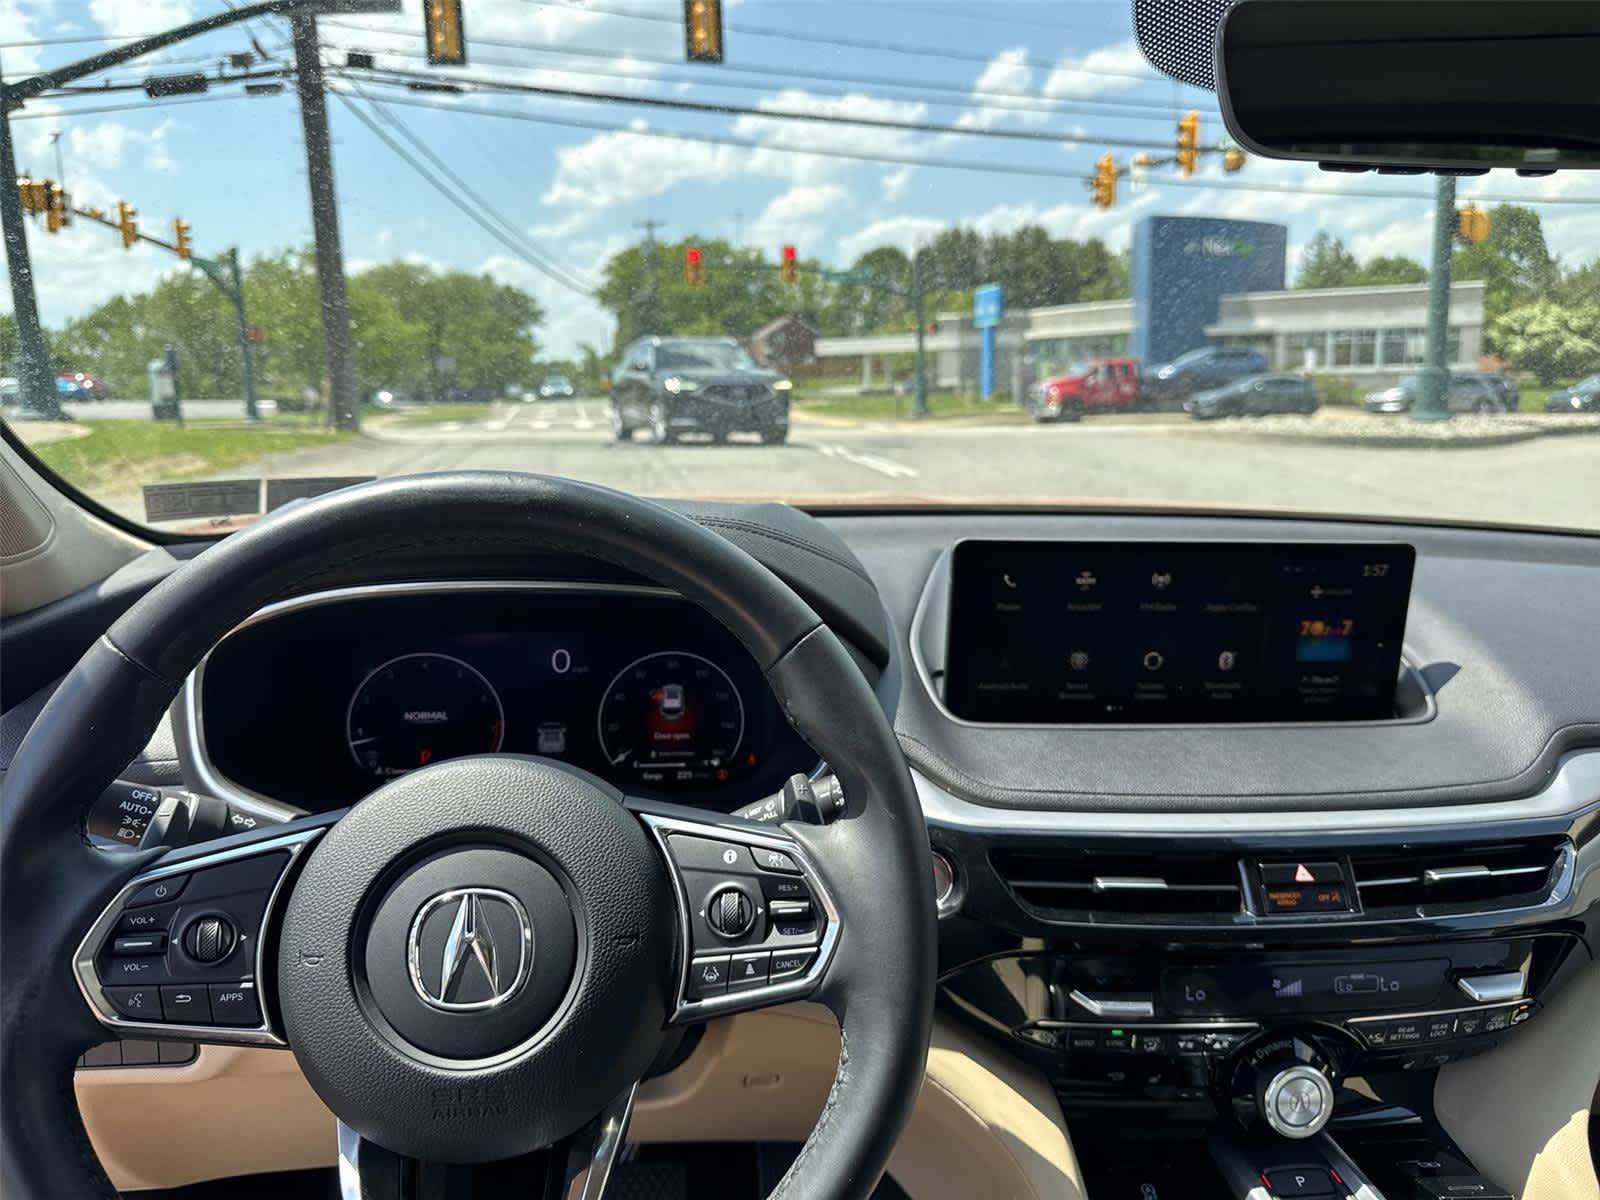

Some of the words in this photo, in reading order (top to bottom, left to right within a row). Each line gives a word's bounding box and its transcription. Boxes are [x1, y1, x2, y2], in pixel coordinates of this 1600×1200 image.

[551, 649, 571, 674] 0
[404, 711, 448, 721] NORMAL
[131, 789, 153, 801] OFF
[119, 800, 148, 815] AUTO
[775, 959, 802, 970] CANCEL
[1379, 976, 1400, 993] Lo
[219, 992, 244, 1002] APPS
[1184, 984, 1206, 1002] Lo
[1294, 1175, 1306, 1188] P
